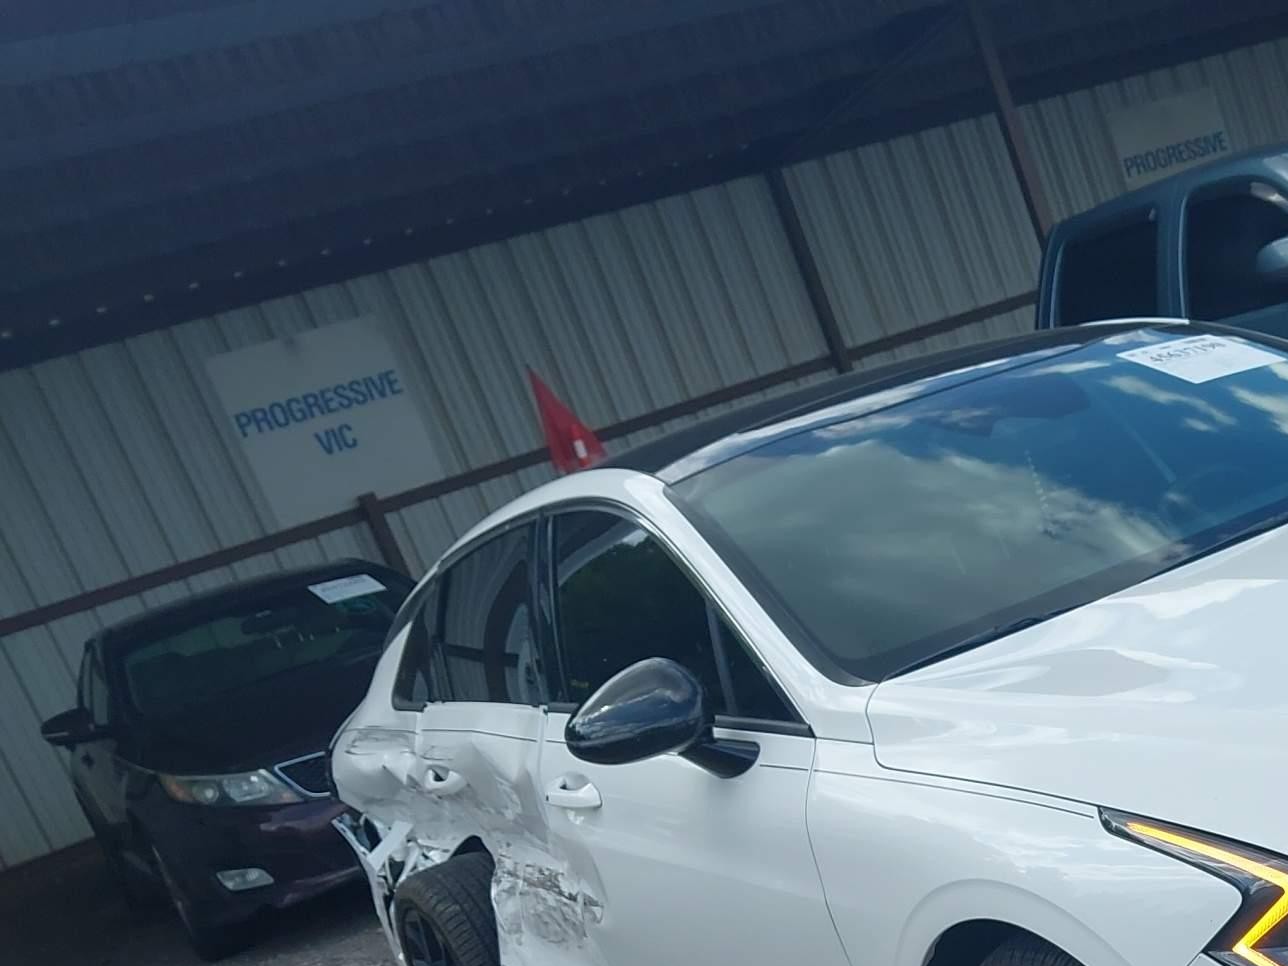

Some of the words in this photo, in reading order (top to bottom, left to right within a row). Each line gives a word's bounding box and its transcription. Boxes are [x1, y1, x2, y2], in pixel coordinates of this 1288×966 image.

[1124, 132, 1227, 177] PROGRESSIVE
[234, 370, 403, 438] PROGRESSIVE
[314, 424, 359, 456] VIC
